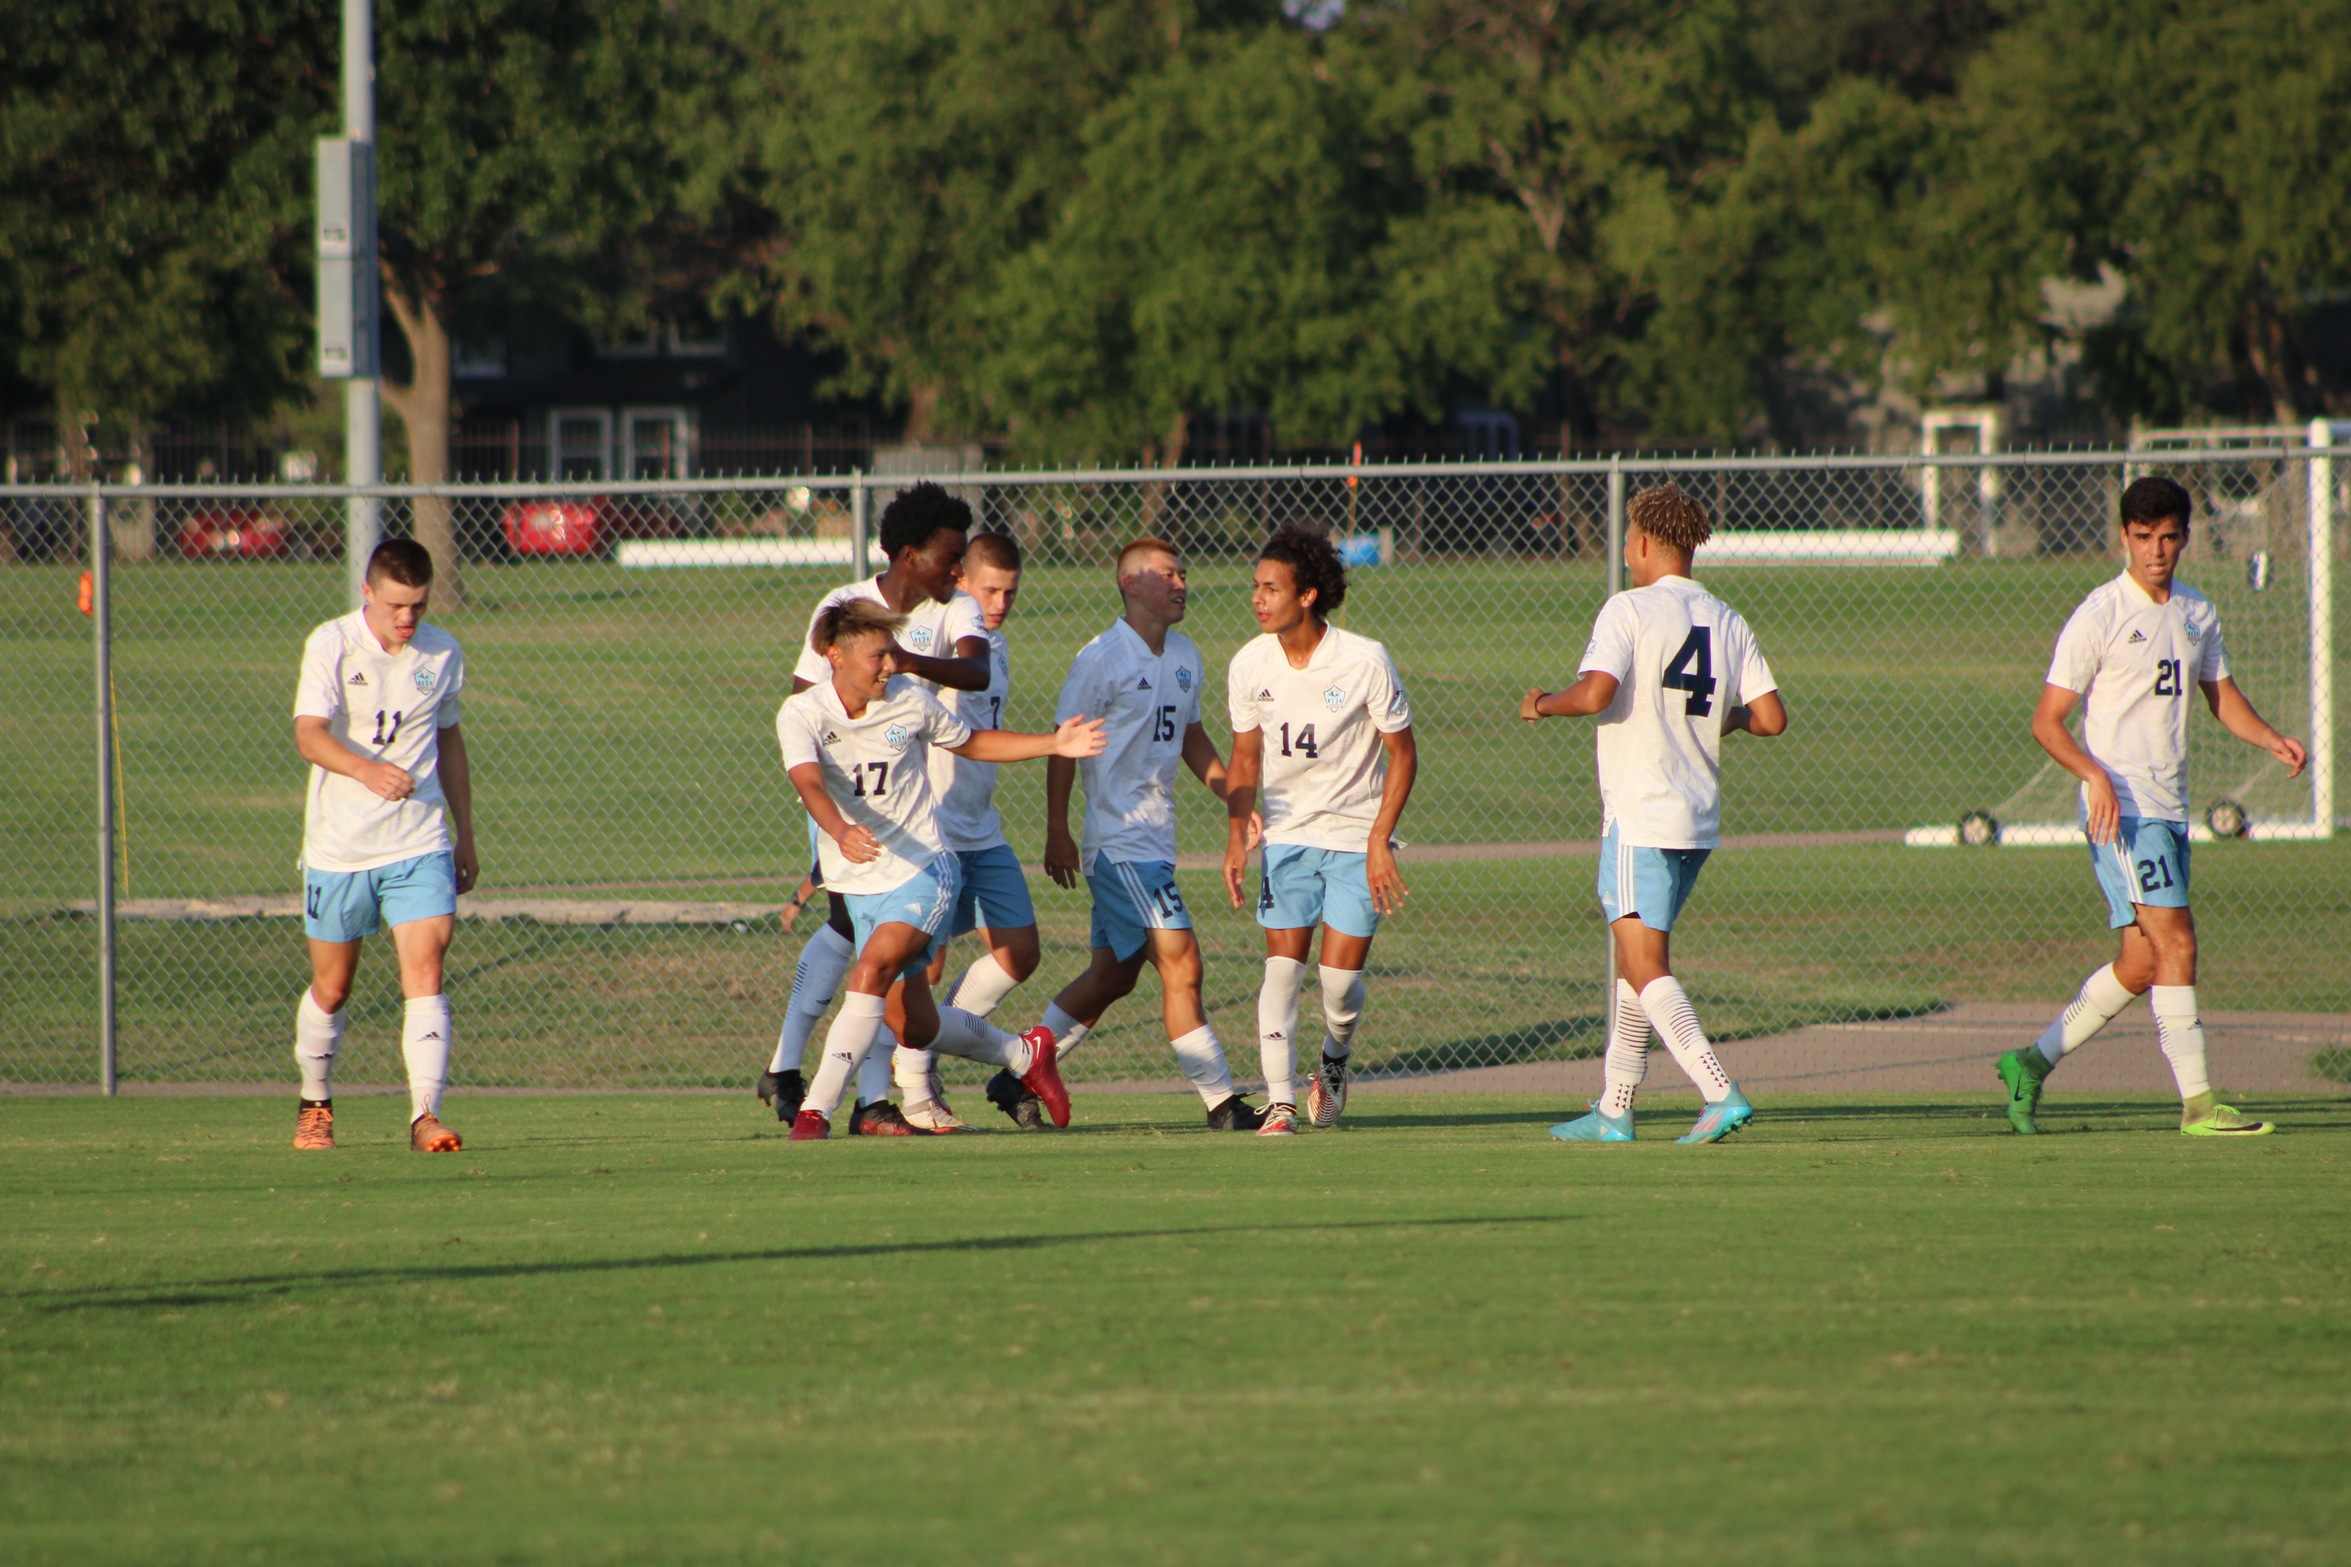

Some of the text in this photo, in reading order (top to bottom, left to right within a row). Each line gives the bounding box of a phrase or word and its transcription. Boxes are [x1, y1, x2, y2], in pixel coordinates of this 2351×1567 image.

[1662, 625, 1717, 718] 4
[2155, 659, 2182, 696] 21
[372, 710, 402, 745] 11
[990, 696, 1000, 730] 7
[1153, 706, 1176, 742] 15
[1280, 722, 1318, 758] 14
[853, 762, 888, 796] 17
[2137, 855, 2174, 893] 21
[307, 883, 322, 920] 11
[1154, 881, 1184, 919] 15
